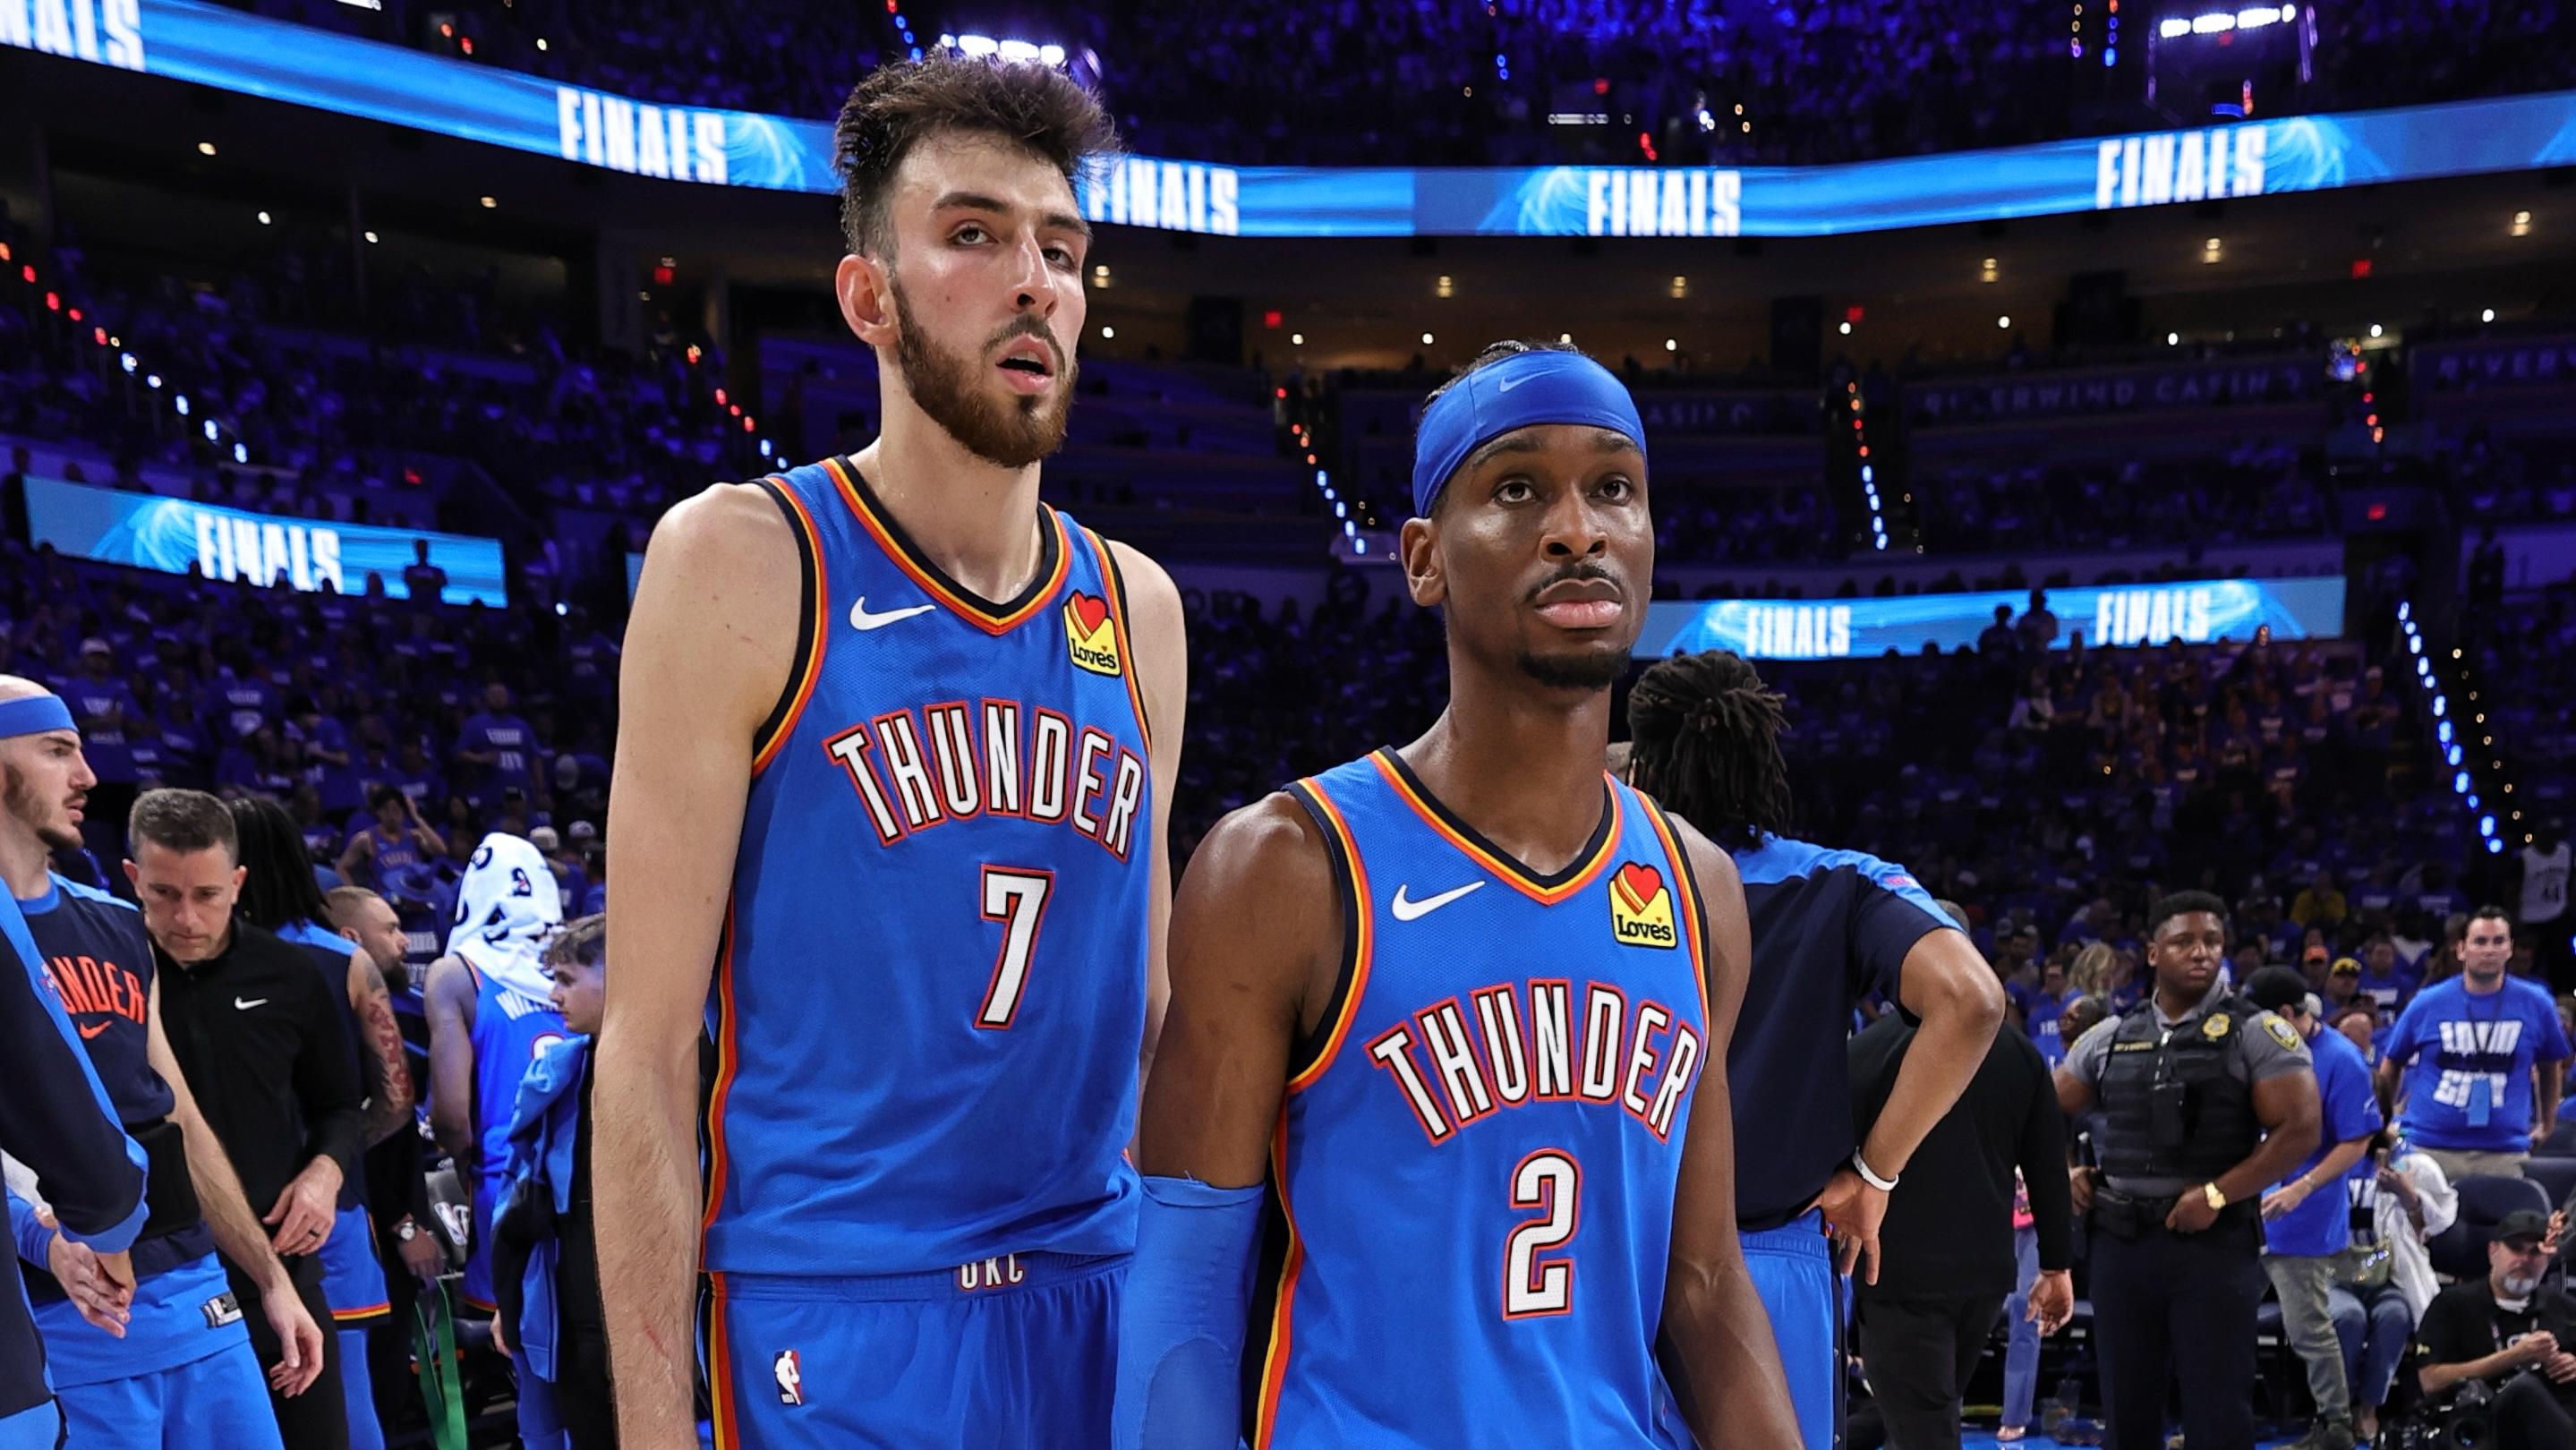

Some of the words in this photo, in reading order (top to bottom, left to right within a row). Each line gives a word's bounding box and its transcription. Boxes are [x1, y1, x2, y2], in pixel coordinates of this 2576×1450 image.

[556, 86, 729, 185] FINALS
[2095, 124, 2267, 209] FINALS
[1086, 155, 1240, 236] FINALS
[1588, 170, 1742, 237] FINALS
[194, 511, 345, 595] FINALS
[1745, 604, 1851, 657] FINALS
[2095, 588, 2211, 645] FINALS
[821, 697, 1143, 863] THUNDER
[974, 863, 1056, 1030] 7
[1362, 977, 1702, 1146] THUNDER
[2433, 1069, 2508, 1109] CIY
[1503, 1147, 1582, 1321] 2
